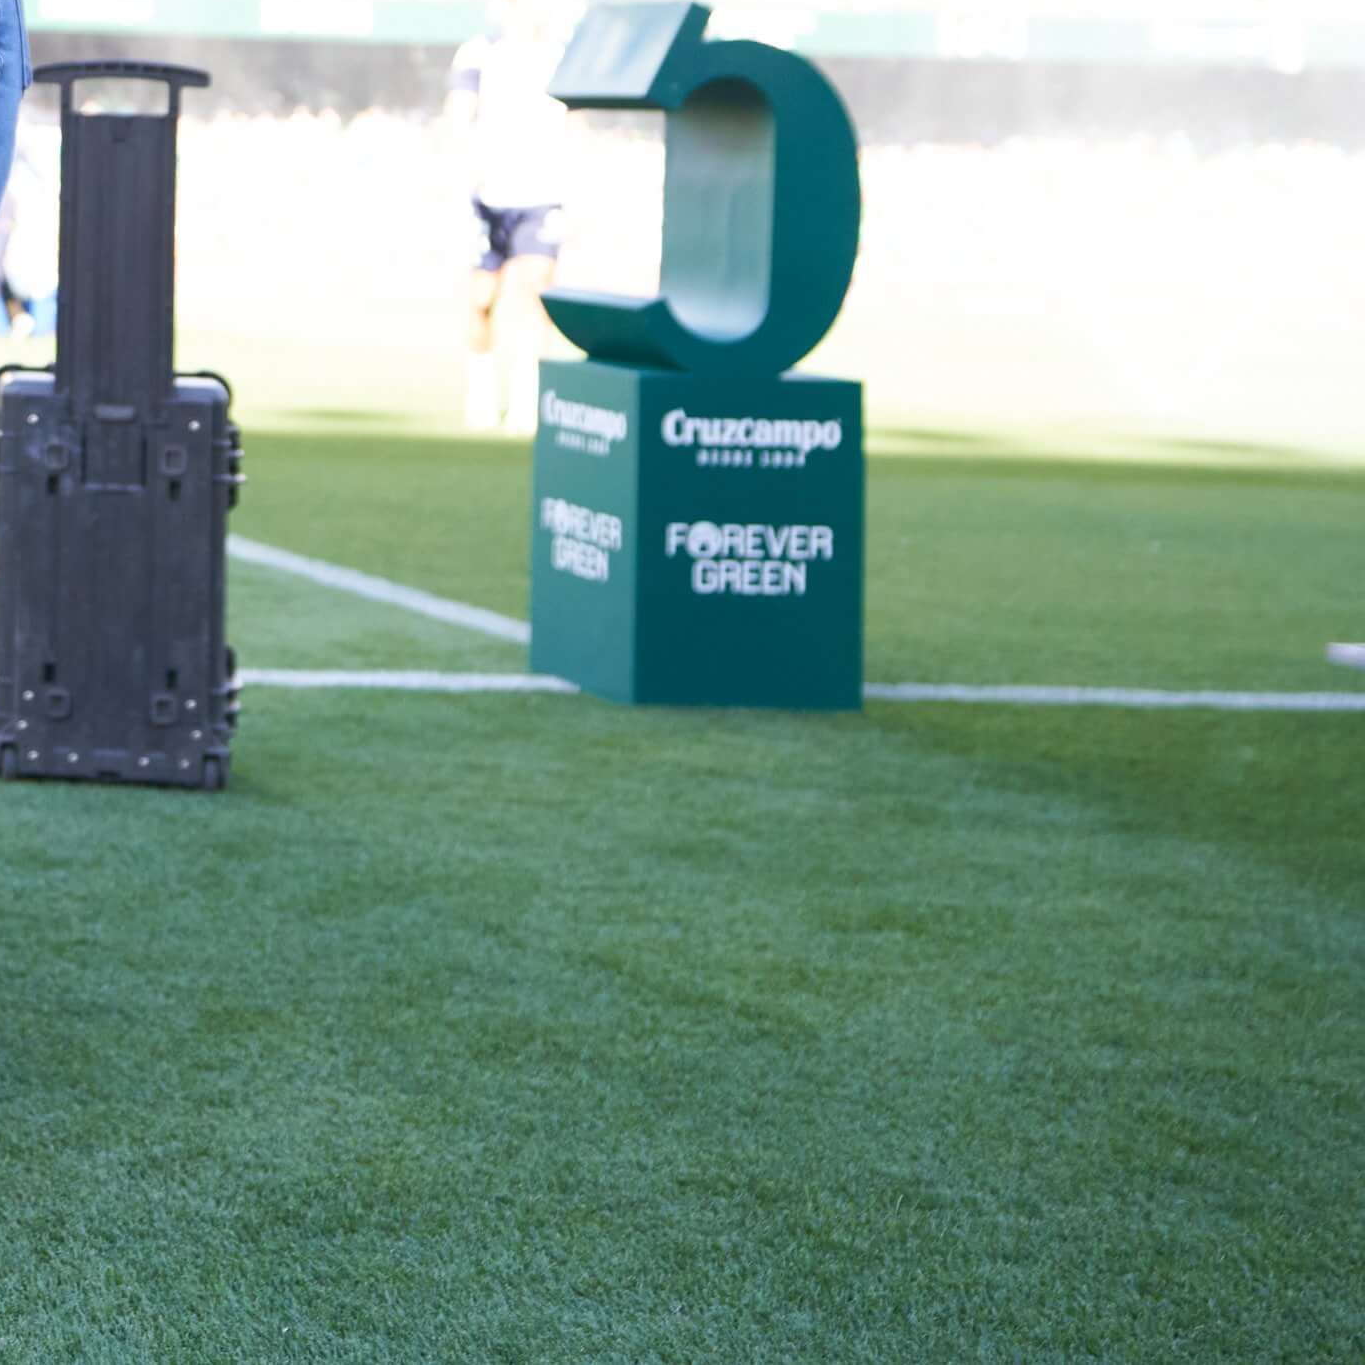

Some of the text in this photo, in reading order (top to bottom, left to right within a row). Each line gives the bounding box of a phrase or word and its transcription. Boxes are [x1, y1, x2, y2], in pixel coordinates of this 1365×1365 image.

[661, 407, 842, 453] Cruzcampo
[665, 521, 833, 561] FOREVER
[692, 559, 806, 596] GREEN
